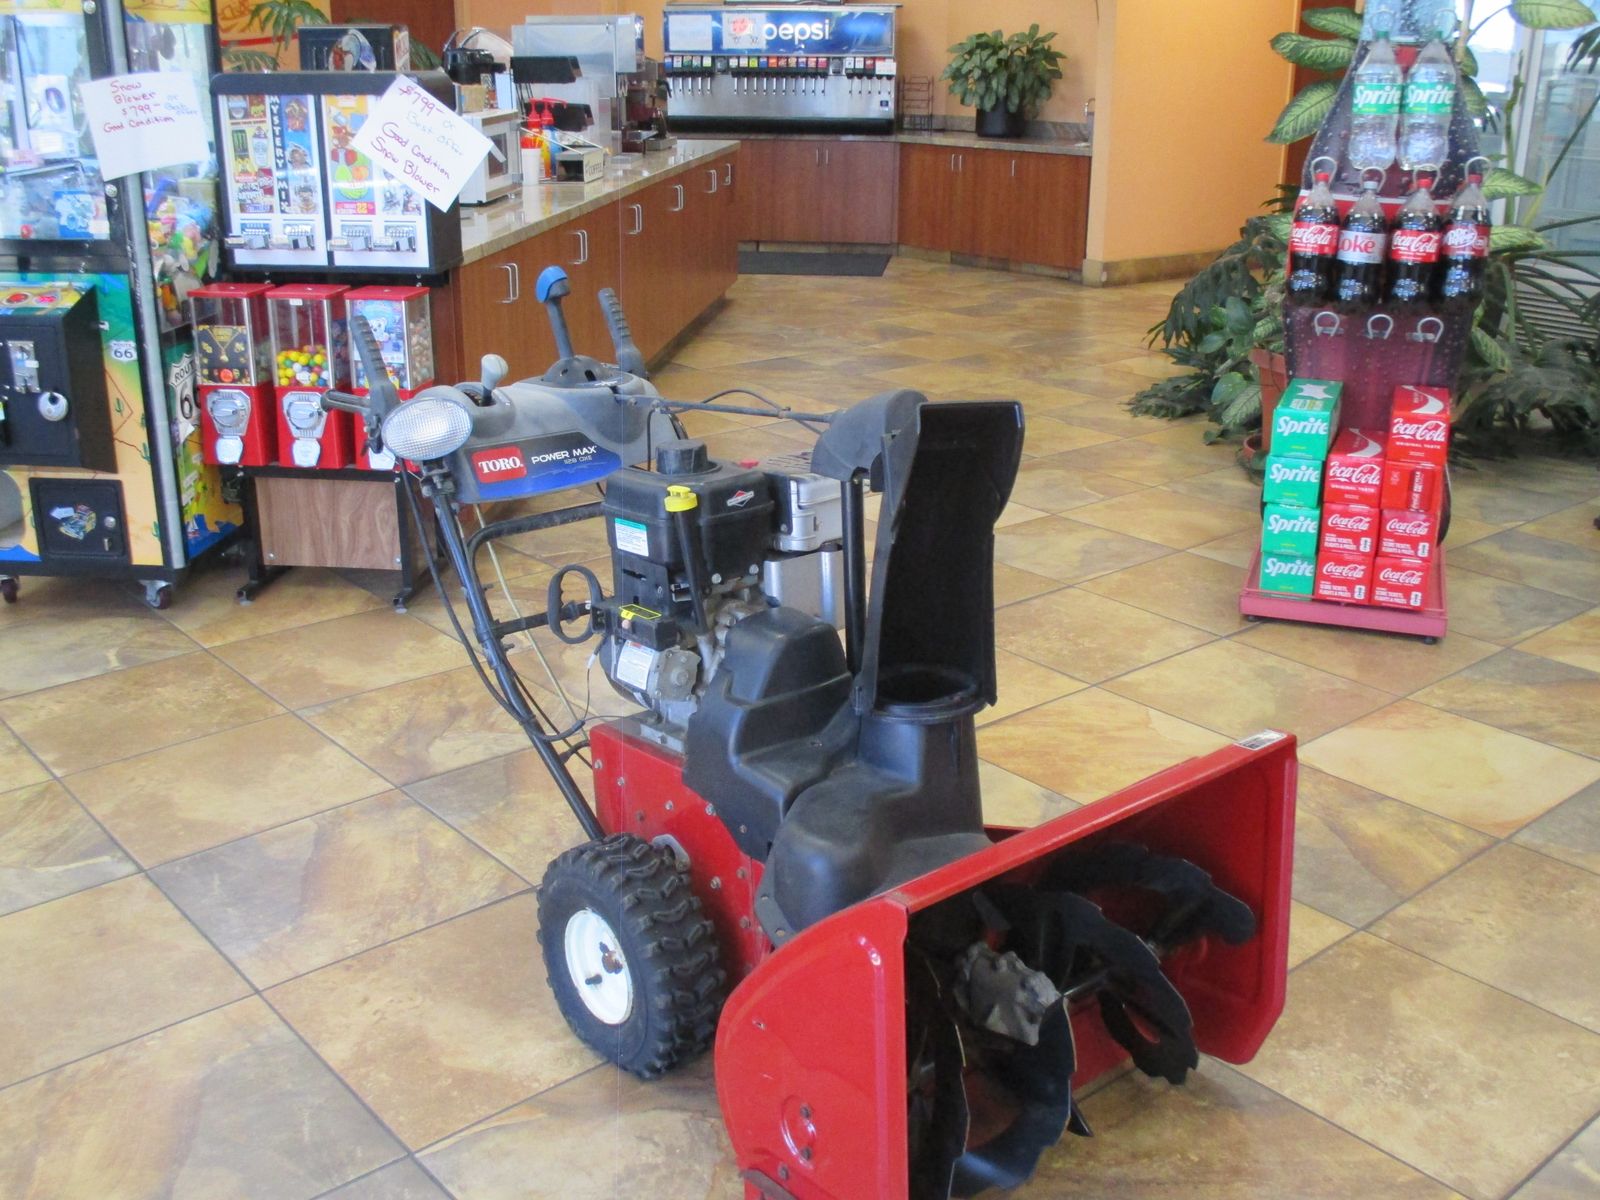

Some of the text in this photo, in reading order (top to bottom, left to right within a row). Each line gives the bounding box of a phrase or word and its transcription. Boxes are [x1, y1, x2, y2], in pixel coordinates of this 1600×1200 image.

[763, 19, 831, 45] pepsi
[110, 80, 142, 93] Snow
[113, 91, 157, 104] Blower
[103, 116, 175, 133] Good Condition
[269, 95, 285, 169] MYSTERY
[382, 121, 451, 180] Good Condition
[370, 136, 441, 193] Snow Blower
[1338, 236, 1376, 254] oke
[114, 349, 134, 359] 66
[174, 360, 196, 382] ROUT
[1277, 416, 1329, 436] Sprite
[531, 450, 570, 465] POWER
[572, 446, 597, 457] MAX
[1269, 463, 1320, 483] Sprite
[1267, 514, 1317, 534] Sprite
[1328, 514, 1372, 532] Coca-Cola
[1386, 518, 1430, 535] Coca-Cola
[1265, 558, 1314, 577] Sprite
[1323, 562, 1366, 579] Coca-Cola
[1380, 568, 1424, 585] Coca-Cola
